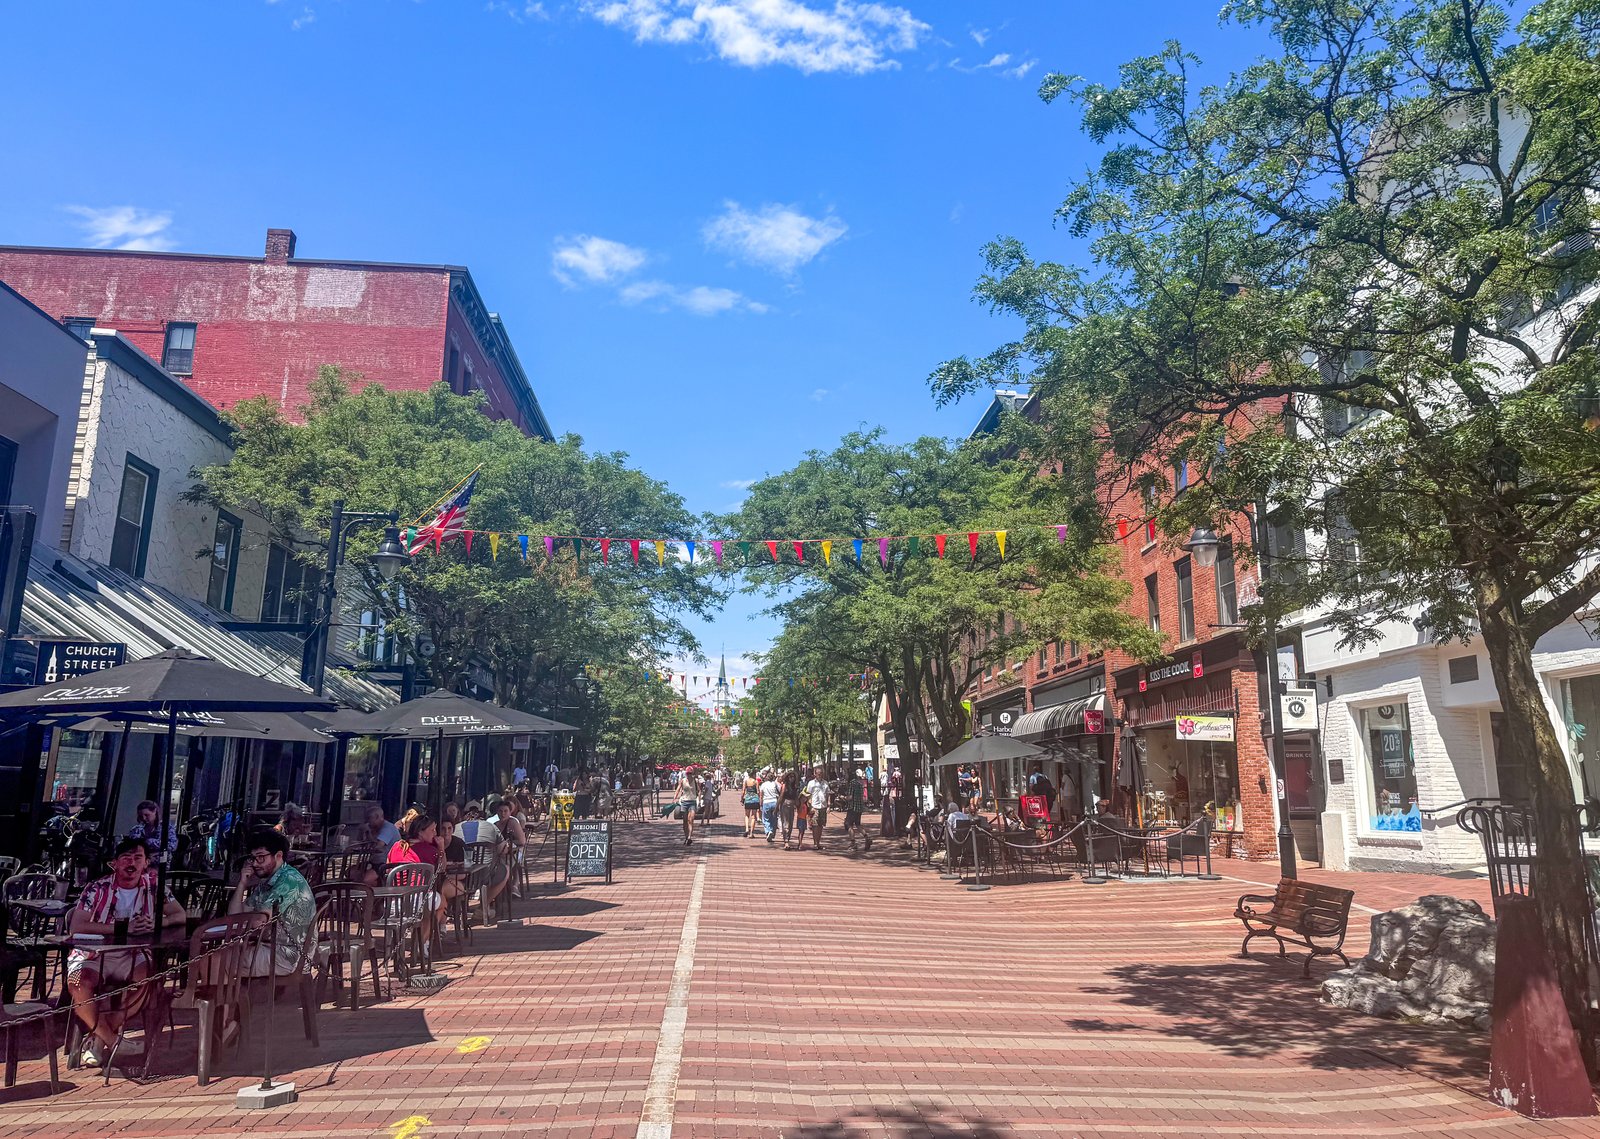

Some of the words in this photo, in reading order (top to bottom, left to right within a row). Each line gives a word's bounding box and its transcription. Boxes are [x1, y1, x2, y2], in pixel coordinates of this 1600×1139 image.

[66, 646, 117, 656] CHURCH
[64, 660, 116, 670] STREET
[1161, 666, 1171, 679] THE
[1172, 660, 1190, 676] COOK
[570, 843, 606, 859] OPEN
